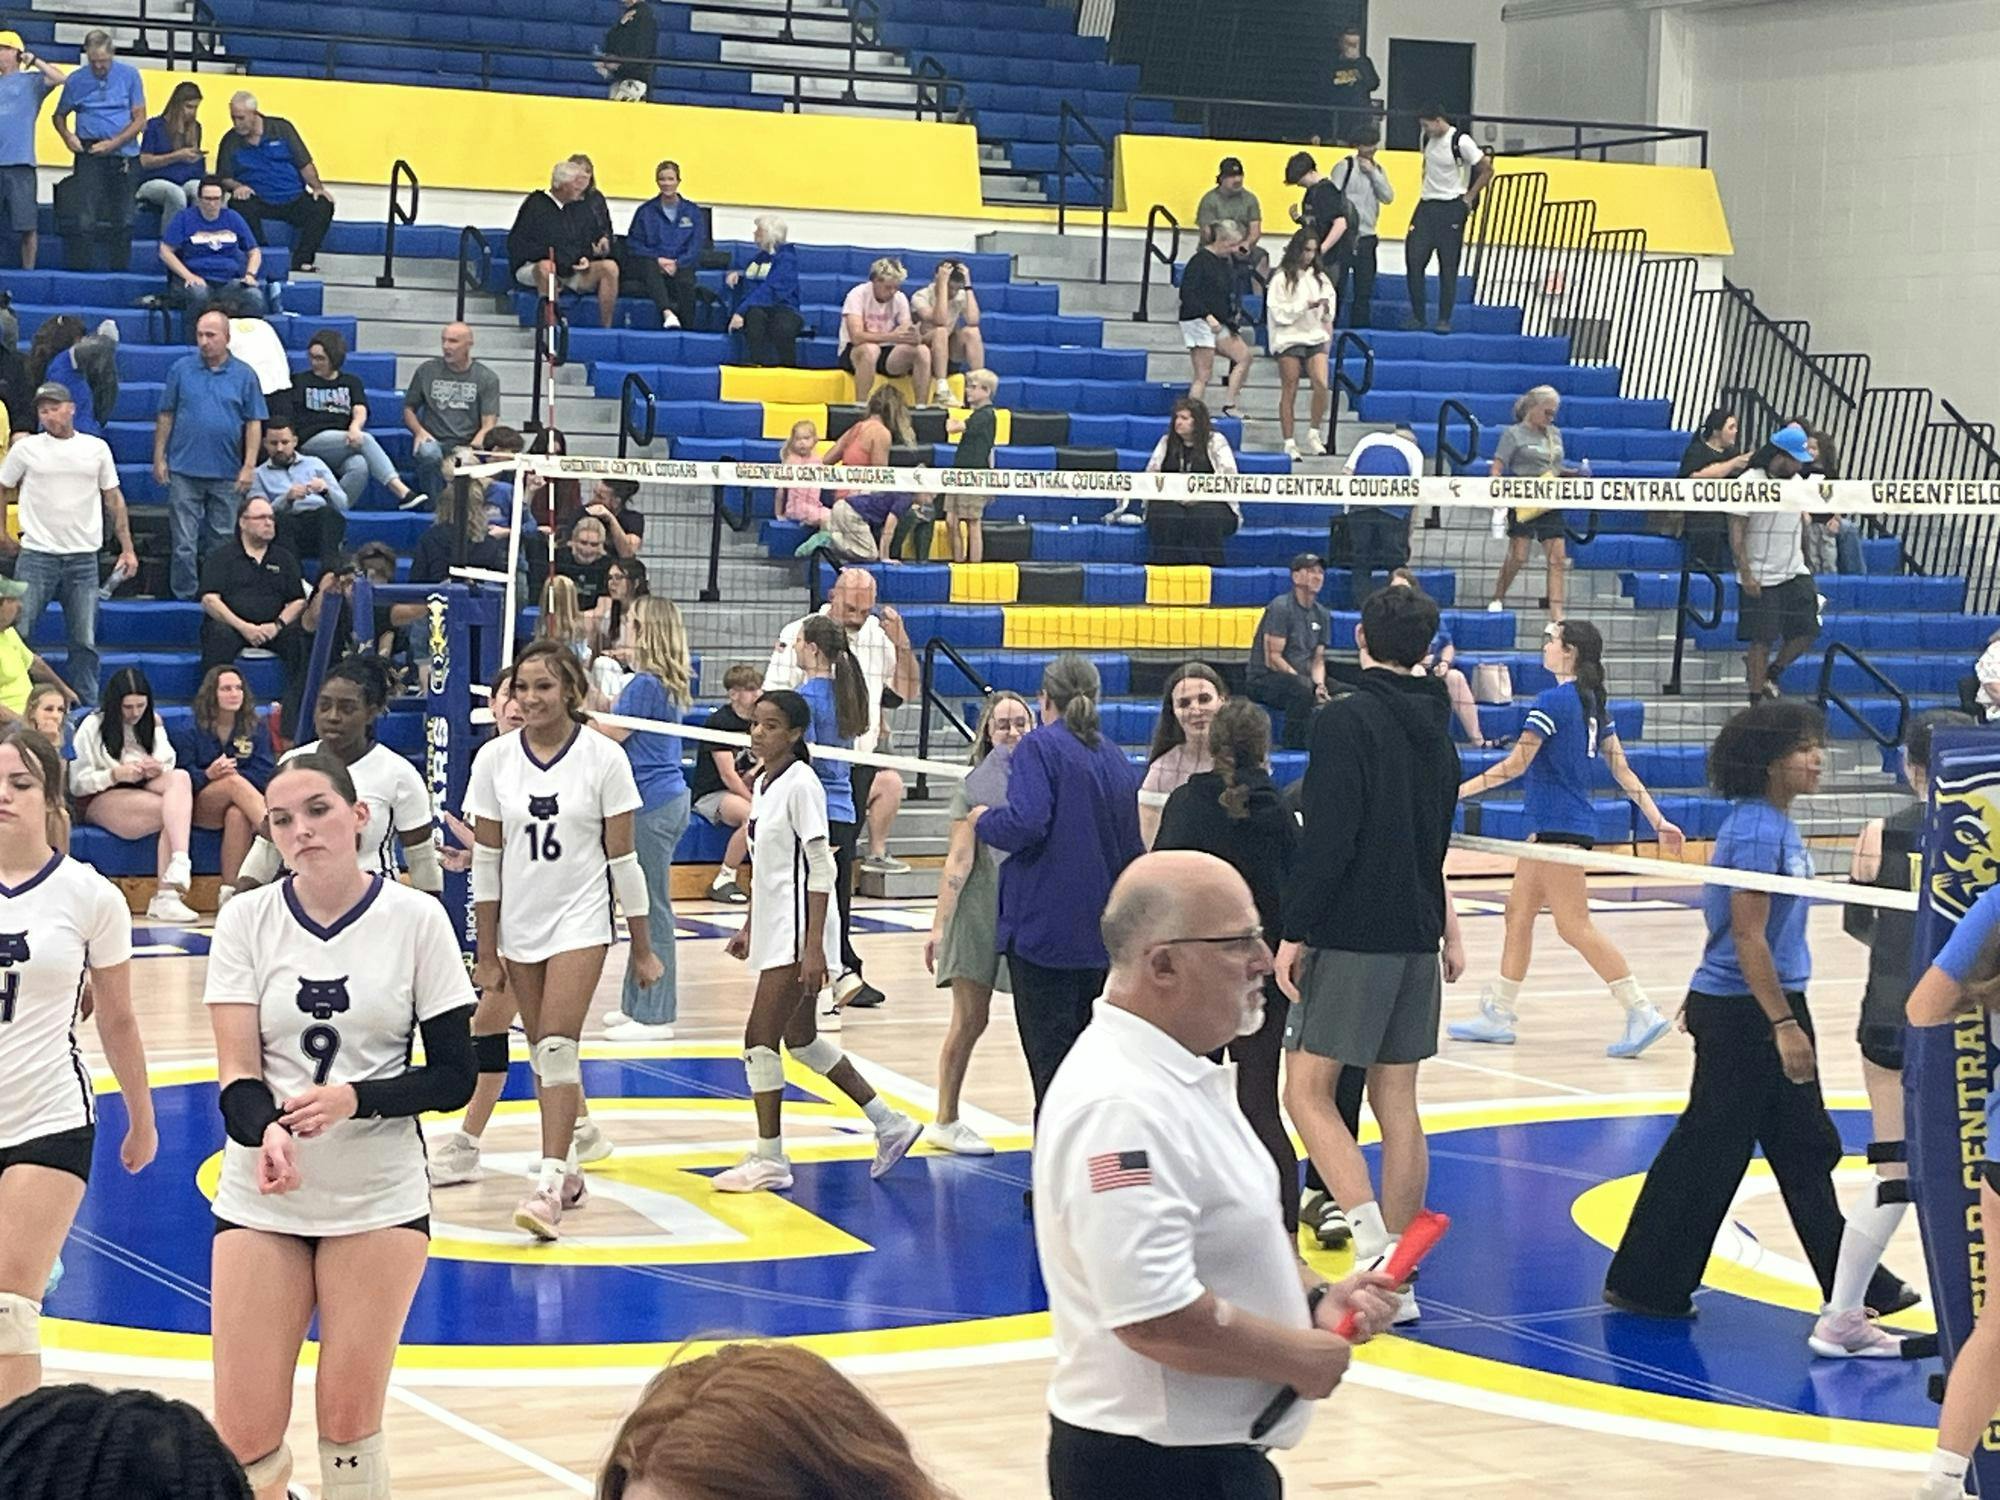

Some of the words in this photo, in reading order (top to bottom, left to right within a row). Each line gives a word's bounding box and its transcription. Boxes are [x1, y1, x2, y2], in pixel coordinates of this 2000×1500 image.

[735, 464, 794, 480] GREENFIELD
[796, 466, 844, 483] CENTRAL
[846, 468, 896, 485] COUGARS
[940, 470, 1010, 489] GREENFIELD
[1014, 472, 1069, 490] CENTRAL
[1072, 474, 1132, 492] COUGARS
[1186, 475, 1271, 495] GREENFIELD
[1276, 477, 1344, 497] CENTRAL
[1349, 478, 1420, 498] COUGARS
[1489, 479, 1595, 501] GREENFIELD
[1601, 480, 1686, 502] CENTRAL
[1692, 481, 1782, 503] COUGARS
[1871, 482, 2000, 505] GREENFIELD
[524, 822, 562, 862] 16
[300, 1022, 342, 1086] 9
